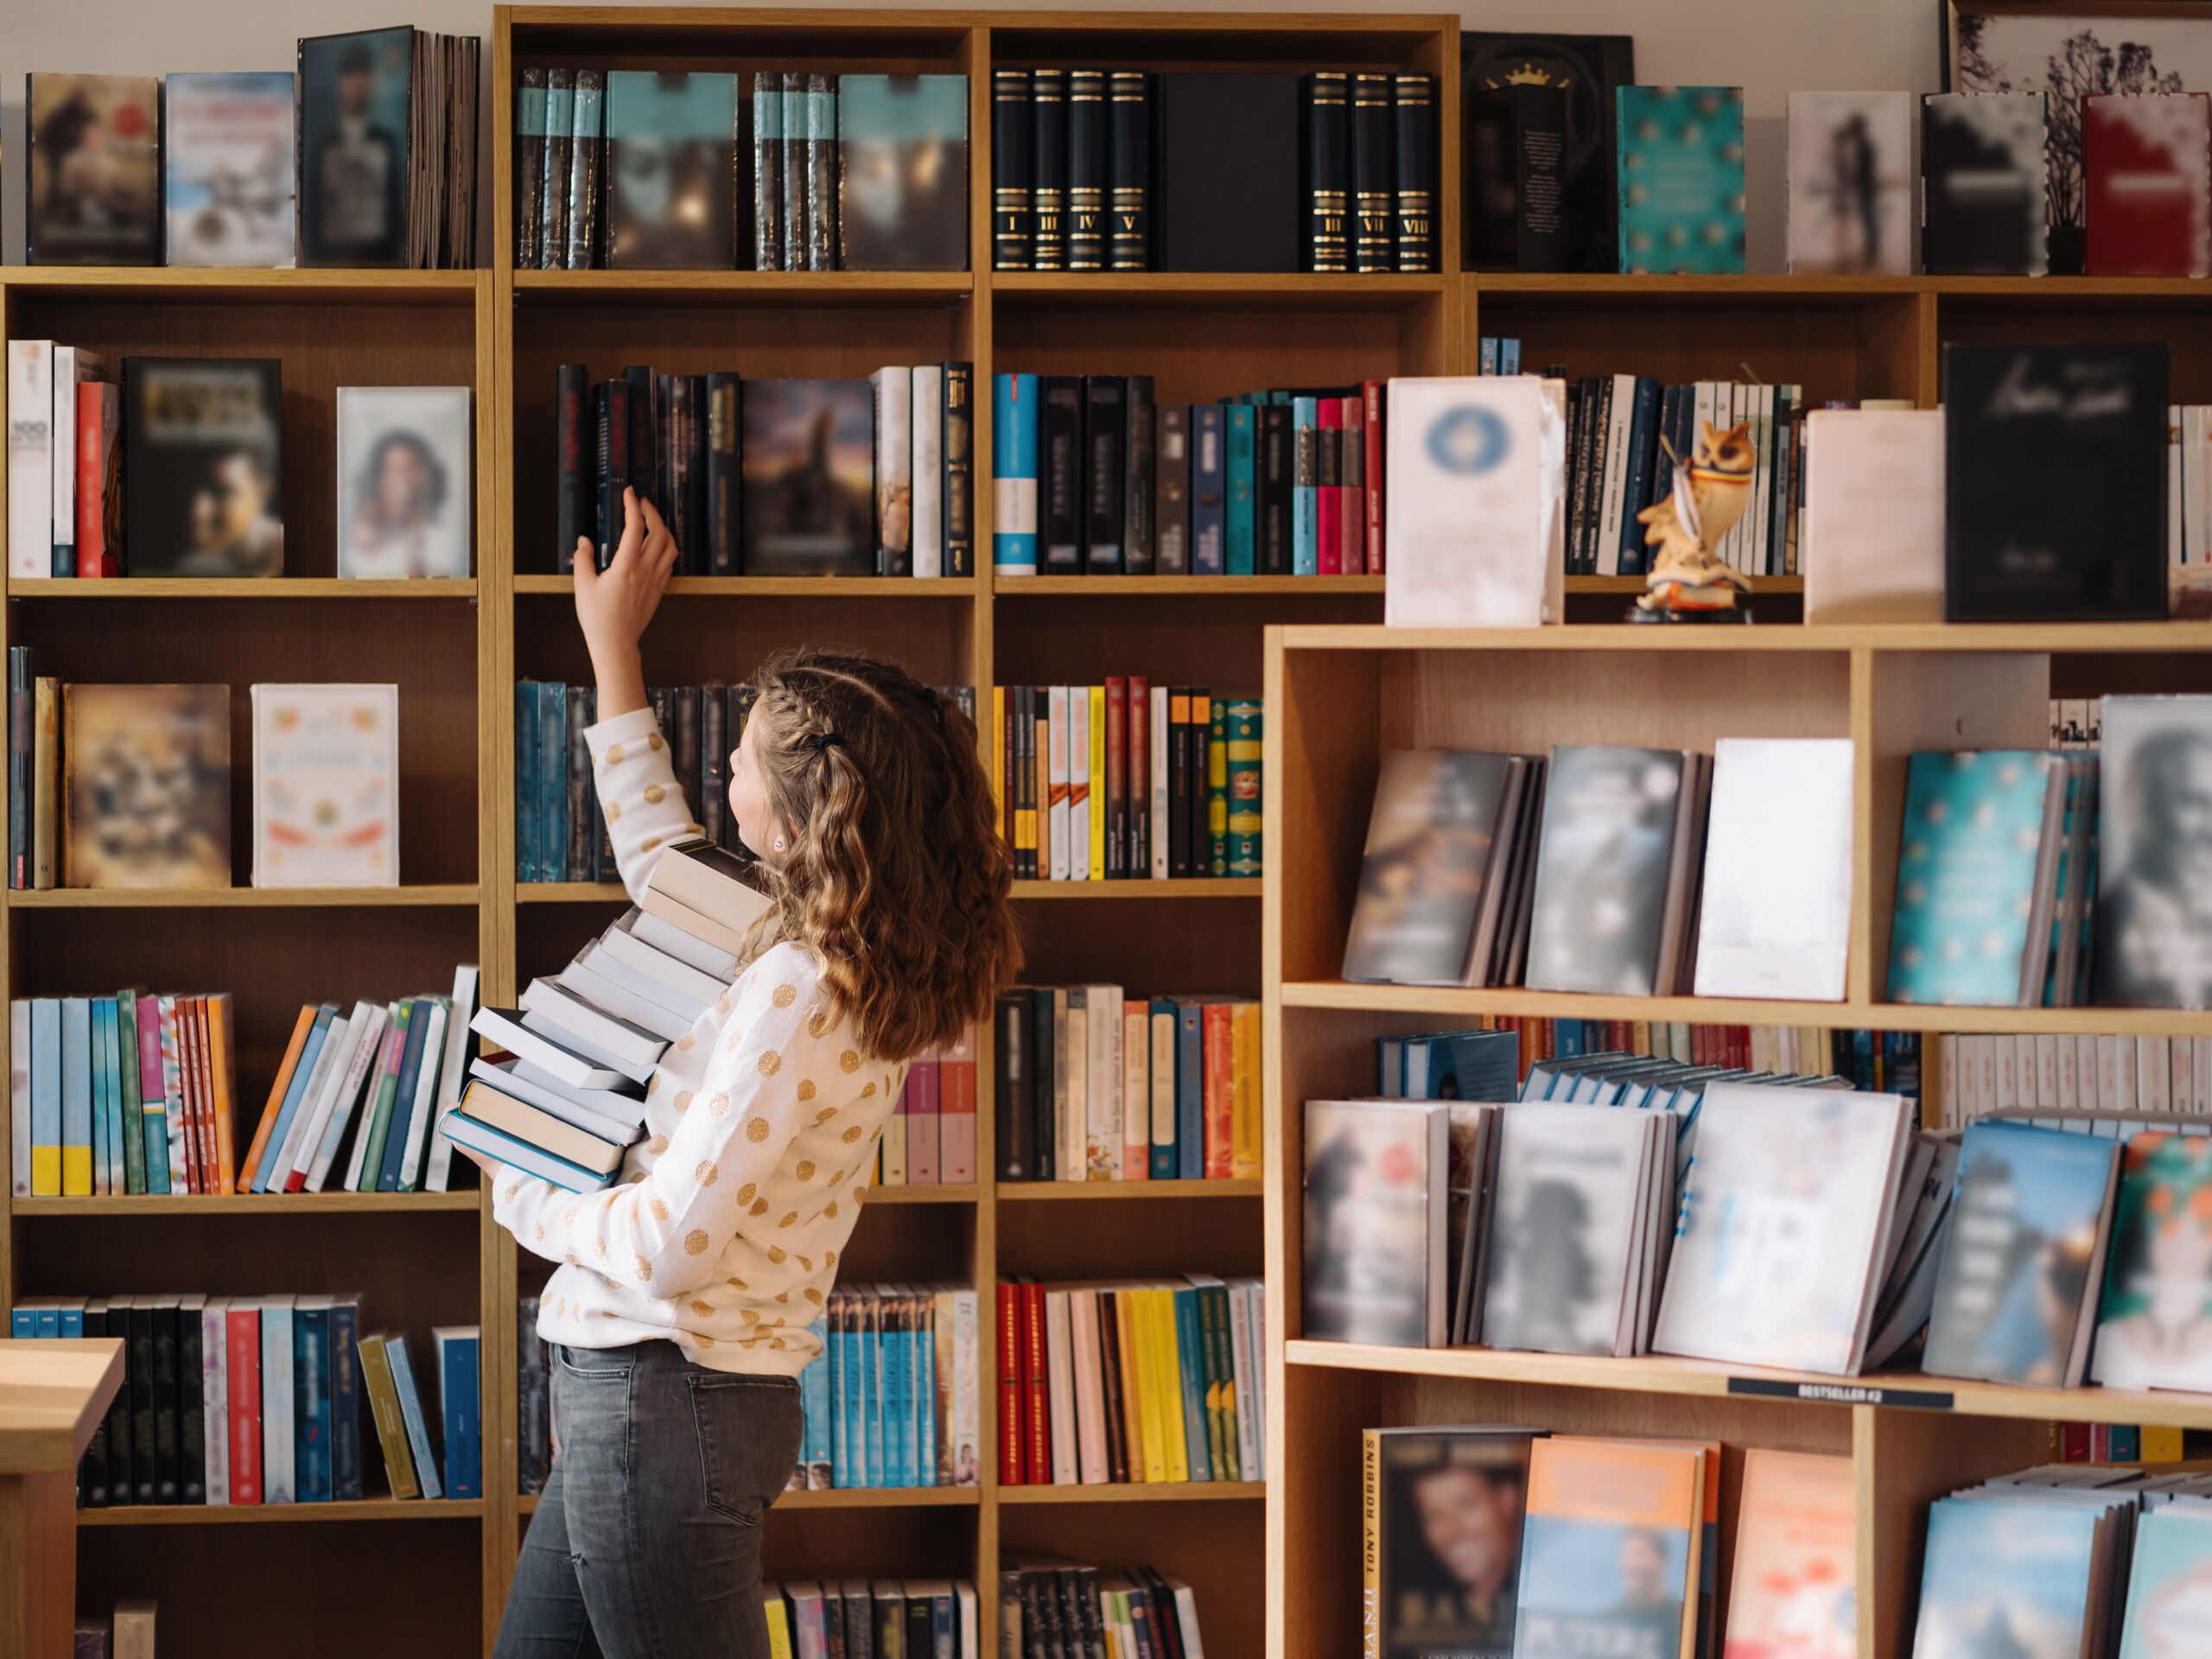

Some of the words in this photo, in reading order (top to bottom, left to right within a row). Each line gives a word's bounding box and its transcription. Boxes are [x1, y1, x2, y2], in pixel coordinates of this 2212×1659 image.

[1009, 216, 1015, 231] I
[1040, 216, 1058, 231] III
[1079, 215, 1096, 229] IV
[1122, 216, 1135, 230] V
[1325, 218, 1341, 232] III
[1363, 218, 1384, 232] VII
[1402, 219, 1428, 233] VIII
[1798, 1383, 1866, 1402] BESTSELLER
[1366, 1439, 1375, 1519] ROBBINS
[1366, 1528, 1375, 1573] TONY
